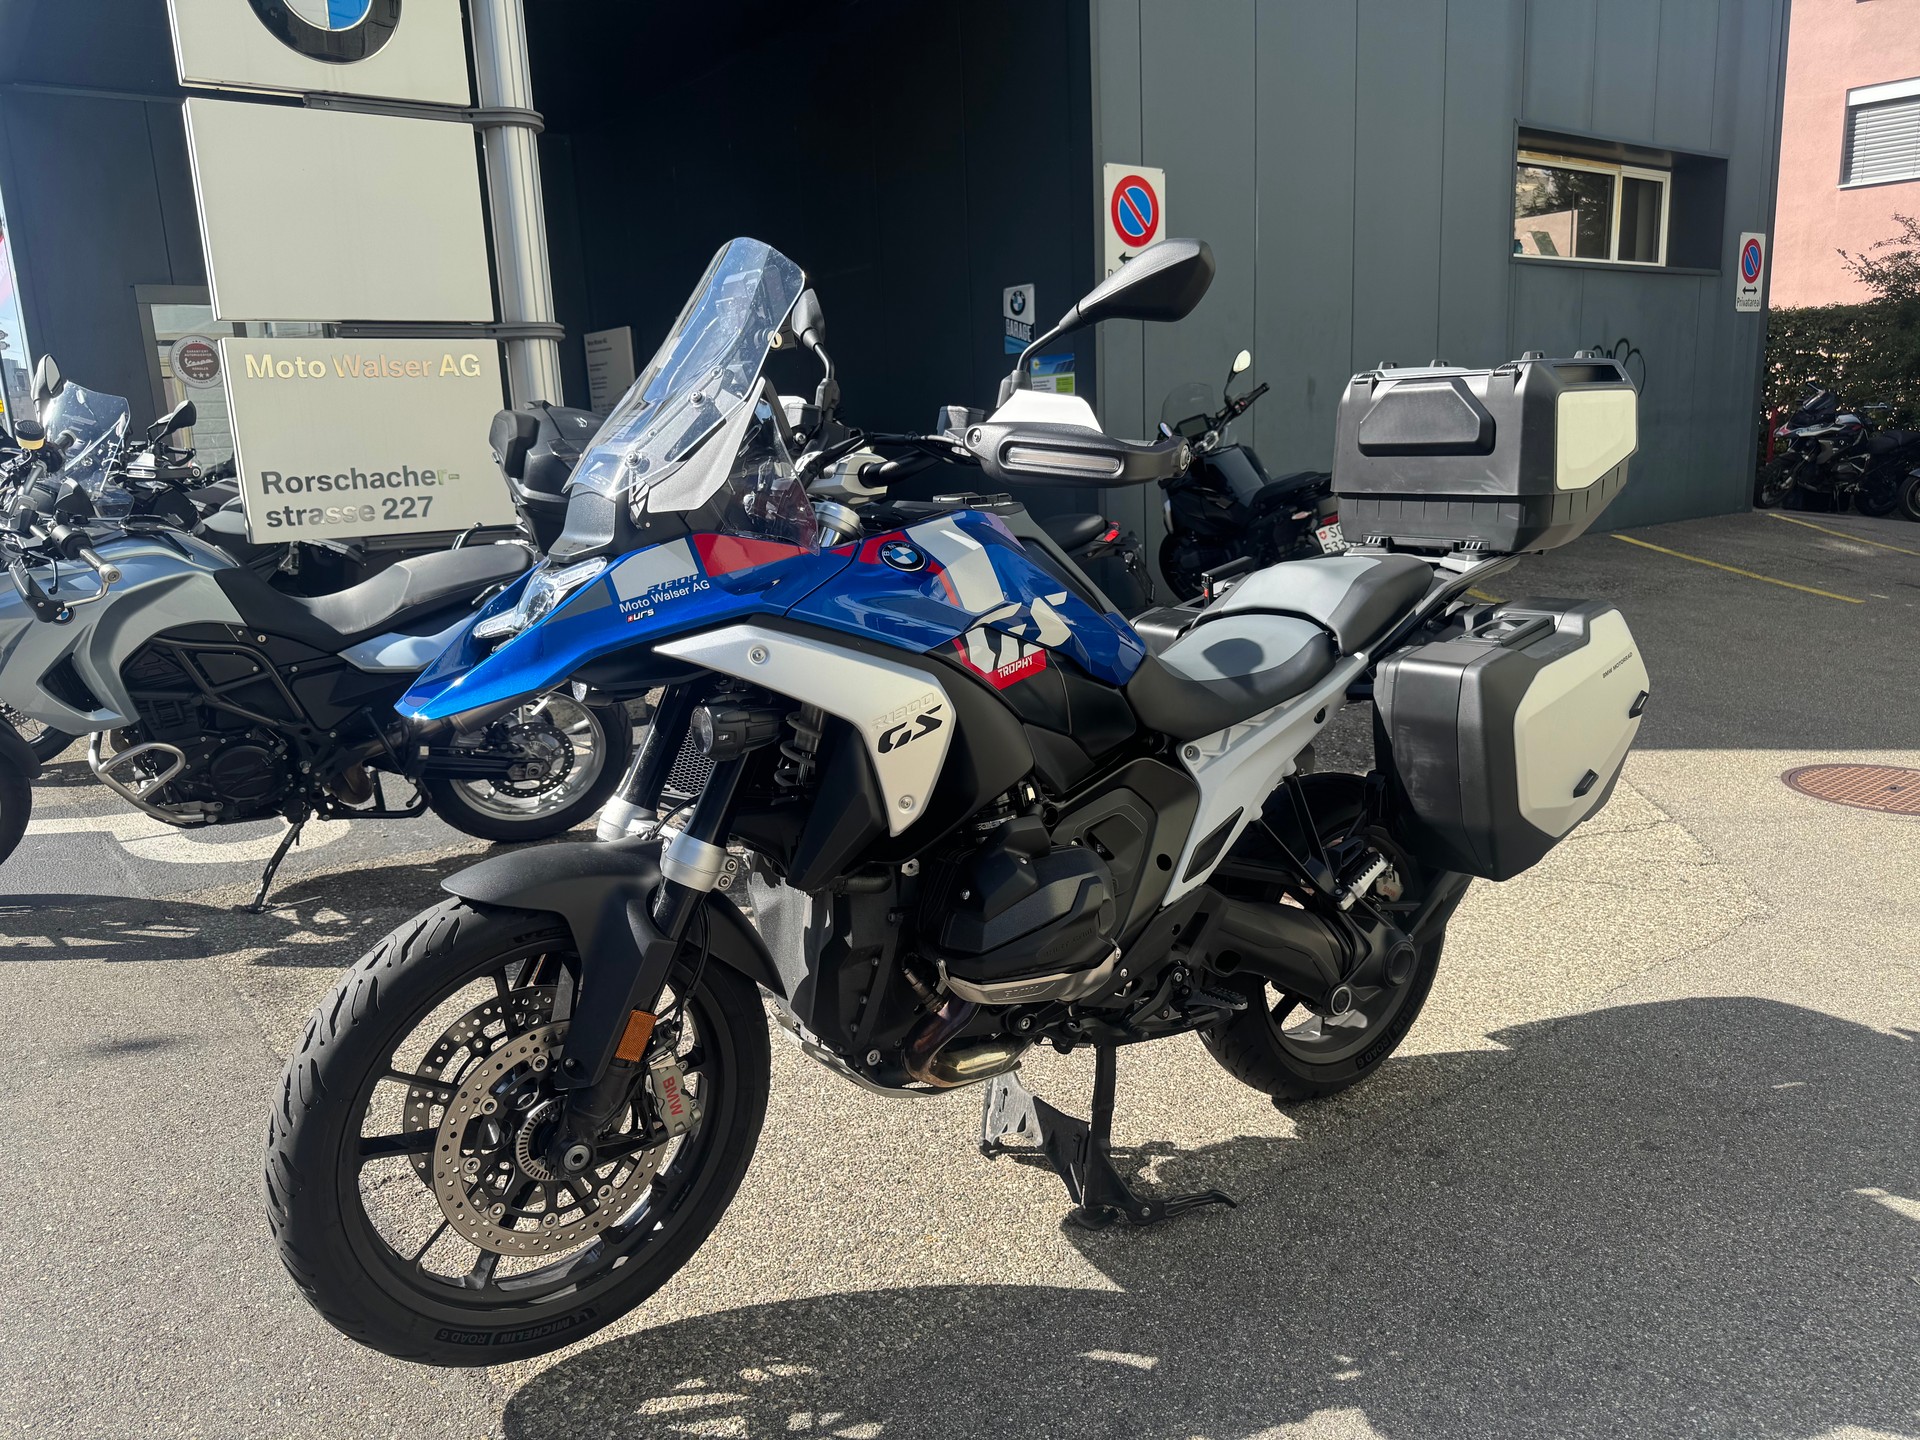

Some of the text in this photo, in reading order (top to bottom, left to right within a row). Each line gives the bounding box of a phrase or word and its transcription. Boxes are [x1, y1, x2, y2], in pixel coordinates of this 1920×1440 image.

[1005, 318, 1032, 343] GARAGE
[244, 353, 481, 378] Moto Walser AG
[260, 465, 460, 495] Rorschacher-
[265, 496, 433, 528] strasse 227
[619, 579, 710, 613] Moto Walser AG
[633, 608, 655, 621] urs
[998, 655, 1033, 679] TROPHY
[1602, 652, 1633, 679] BMW MOTORRAD
[872, 692, 935, 729] R1300
[878, 704, 942, 754] GS
[663, 1076, 683, 1115] BMW
[451, 1332, 487, 1345] ROAD
[501, 1316, 571, 1344] MICHELIN
